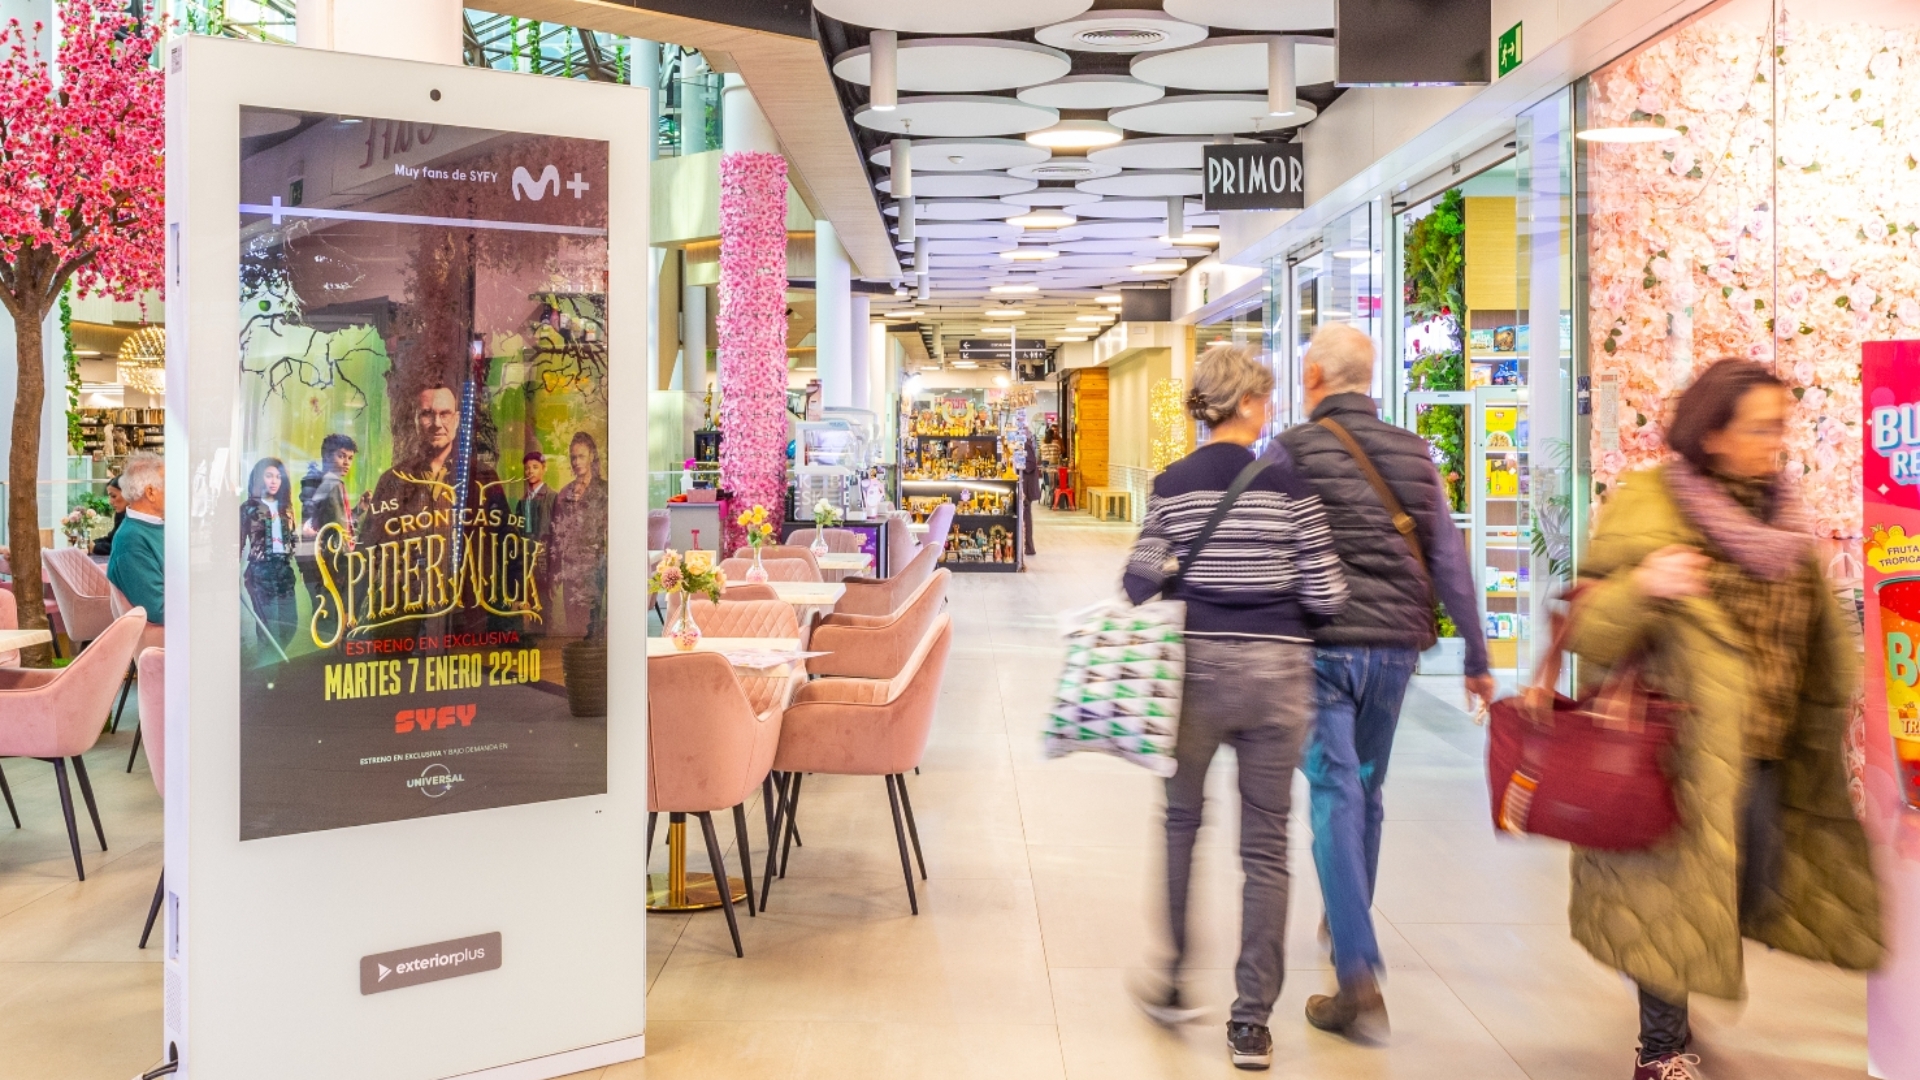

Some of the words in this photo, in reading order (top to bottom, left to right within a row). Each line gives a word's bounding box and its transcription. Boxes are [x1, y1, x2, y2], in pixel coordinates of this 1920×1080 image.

[394, 164, 420, 179] Muy
[422, 166, 449, 179] fans
[451, 168, 467, 181] de
[469, 170, 498, 183] SYFY
[1208, 155, 1303, 194] PRIMOR
[1873, 403, 1920, 450] BU
[371, 498, 399, 515] LAS
[385, 505, 502, 536] CRÓNICAS
[508, 513, 526, 528] DE
[311, 522, 544, 649] SPIDERWICK
[346, 635, 414, 656] ESTRENO
[419, 635, 438, 650] EN
[443, 630, 520, 648] EXCLUSIVA
[325, 659, 401, 700] MARTES
[408, 657, 419, 693] 7
[425, 653, 482, 692] ENERO
[489, 649, 541, 686] 22:00
[1887, 632, 1920, 689] B
[395, 703, 477, 734] SYFY
[360, 755, 392, 766] ESTRENO
[393, 754, 403, 762] EN
[405, 750, 442, 761] EXCLUSIVA
[448, 747, 464, 756] BAJO
[465, 744, 498, 754] DEMANDA
[407, 773, 465, 788] UNIVERSAL
[396, 948, 485, 974] exteriorplus
